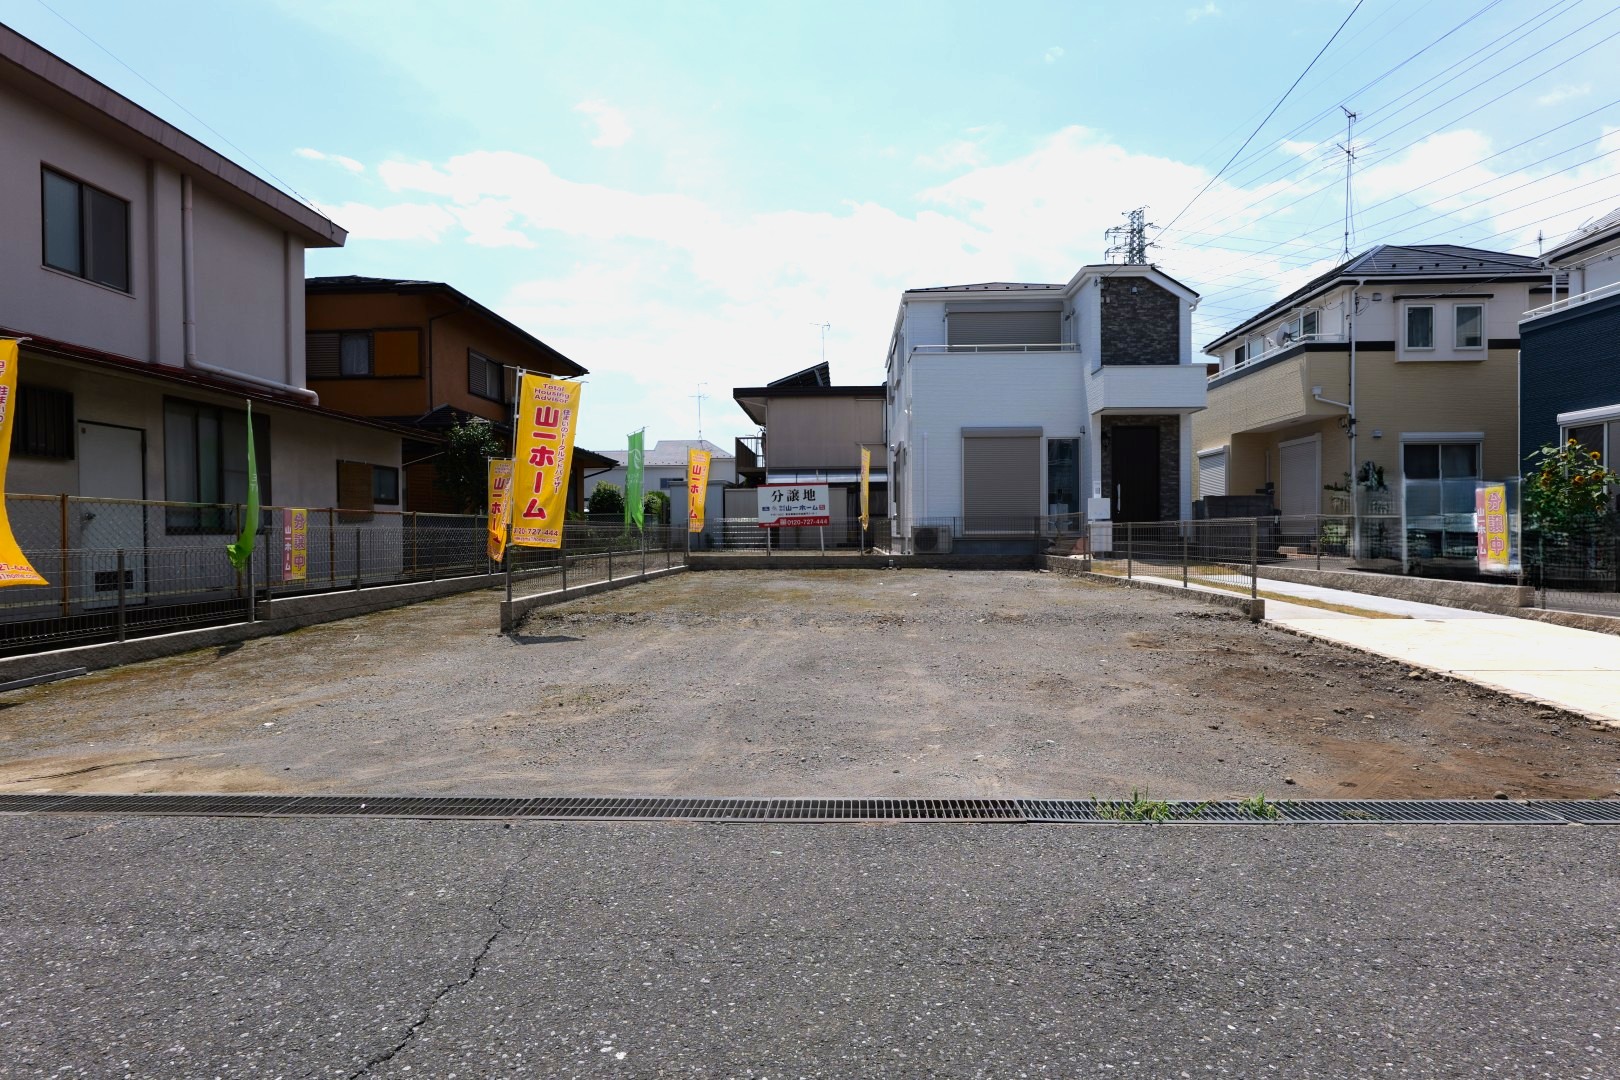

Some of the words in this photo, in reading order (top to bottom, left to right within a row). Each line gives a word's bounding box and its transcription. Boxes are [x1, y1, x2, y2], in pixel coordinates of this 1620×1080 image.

[534, 388, 570, 399] Housing
[534, 395, 569, 404] Advisor
[543, 383, 565, 392] Total
[523, 406, 560, 519] 山一ホーム
[689, 464, 702, 519] 山一ホーム
[771, 488, 816, 503] 分譲地
[785, 504, 818, 512] 山一ホーム
[294, 512, 305, 571] 分譲中
[1477, 507, 1487, 555] 山一ホーム
[1487, 491, 1504, 556] 分譲中
[284, 525, 292, 571] 山一ホーム
